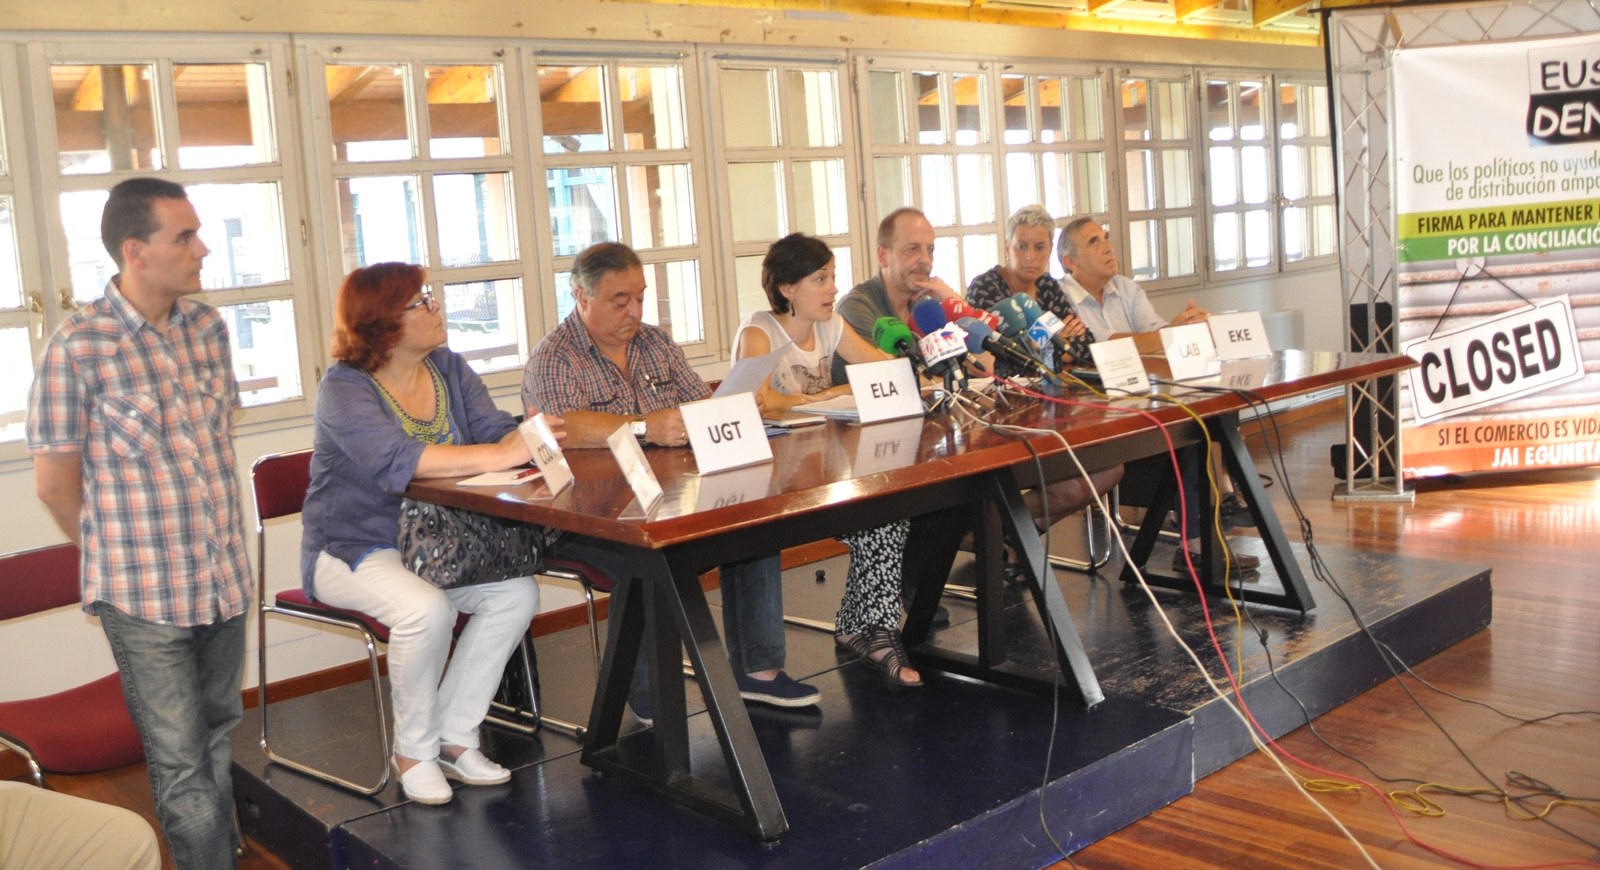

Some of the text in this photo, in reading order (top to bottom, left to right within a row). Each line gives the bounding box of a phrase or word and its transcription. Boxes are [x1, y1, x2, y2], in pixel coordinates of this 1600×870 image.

[1413, 149, 1600, 184] Que los políticos no ayud
[1446, 180, 1463, 200] de
[1468, 174, 1555, 199] distribución
[1418, 204, 1593, 233] FIRMA PARA MANTENER
[1447, 236, 1479, 256] POR
[1483, 234, 1501, 253] LA
[1228, 328, 1252, 343] EKE
[1179, 343, 1200, 358] LAB
[1421, 318, 1562, 404] CLOSED
[871, 381, 899, 399] ELA
[708, 421, 742, 444] UGT
[1438, 428, 1450, 446] SI
[1455, 427, 1469, 444] EL
[1474, 421, 1550, 442] COMERCIO
[1554, 420, 1568, 437] ES
[1491, 447, 1519, 467] JAI
